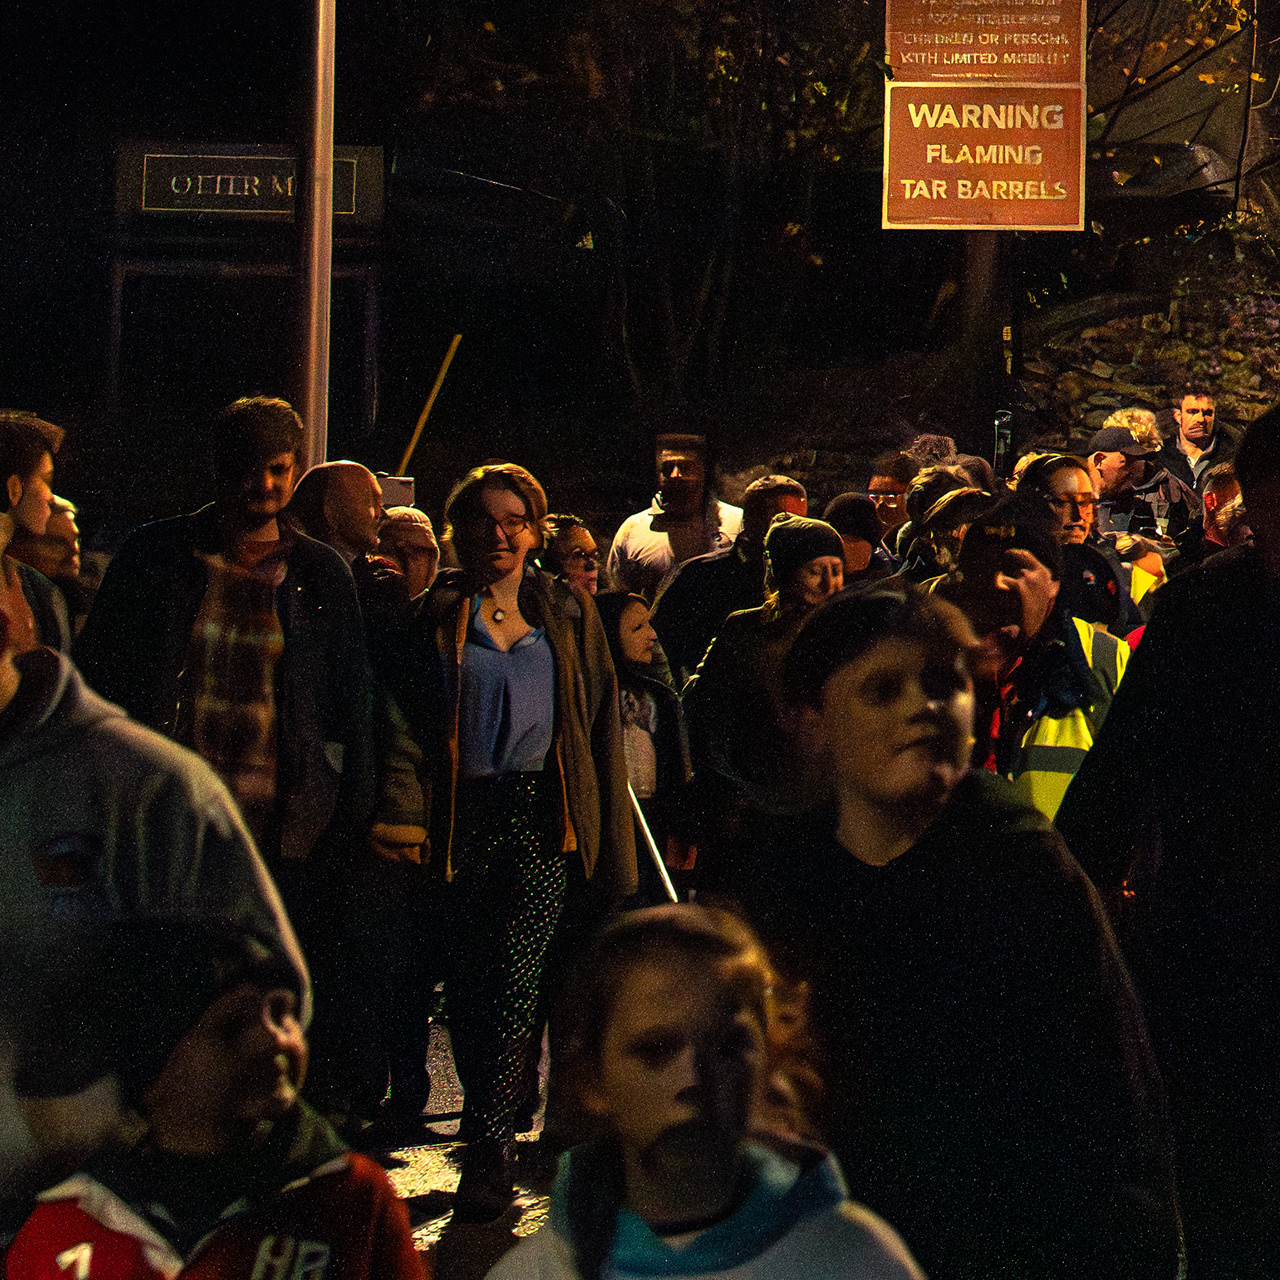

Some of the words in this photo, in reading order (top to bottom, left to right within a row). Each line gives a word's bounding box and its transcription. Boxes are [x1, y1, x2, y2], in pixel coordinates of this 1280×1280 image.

[978, 32, 1000, 45] OR
[943, 51, 998, 65] LIMITED
[908, 103, 1064, 129] WARNING
[926, 144, 1043, 165] FLAMING
[170, 174, 260, 197] OTTER
[901, 179, 948, 200] TAR
[957, 179, 1068, 200] BARRELS
